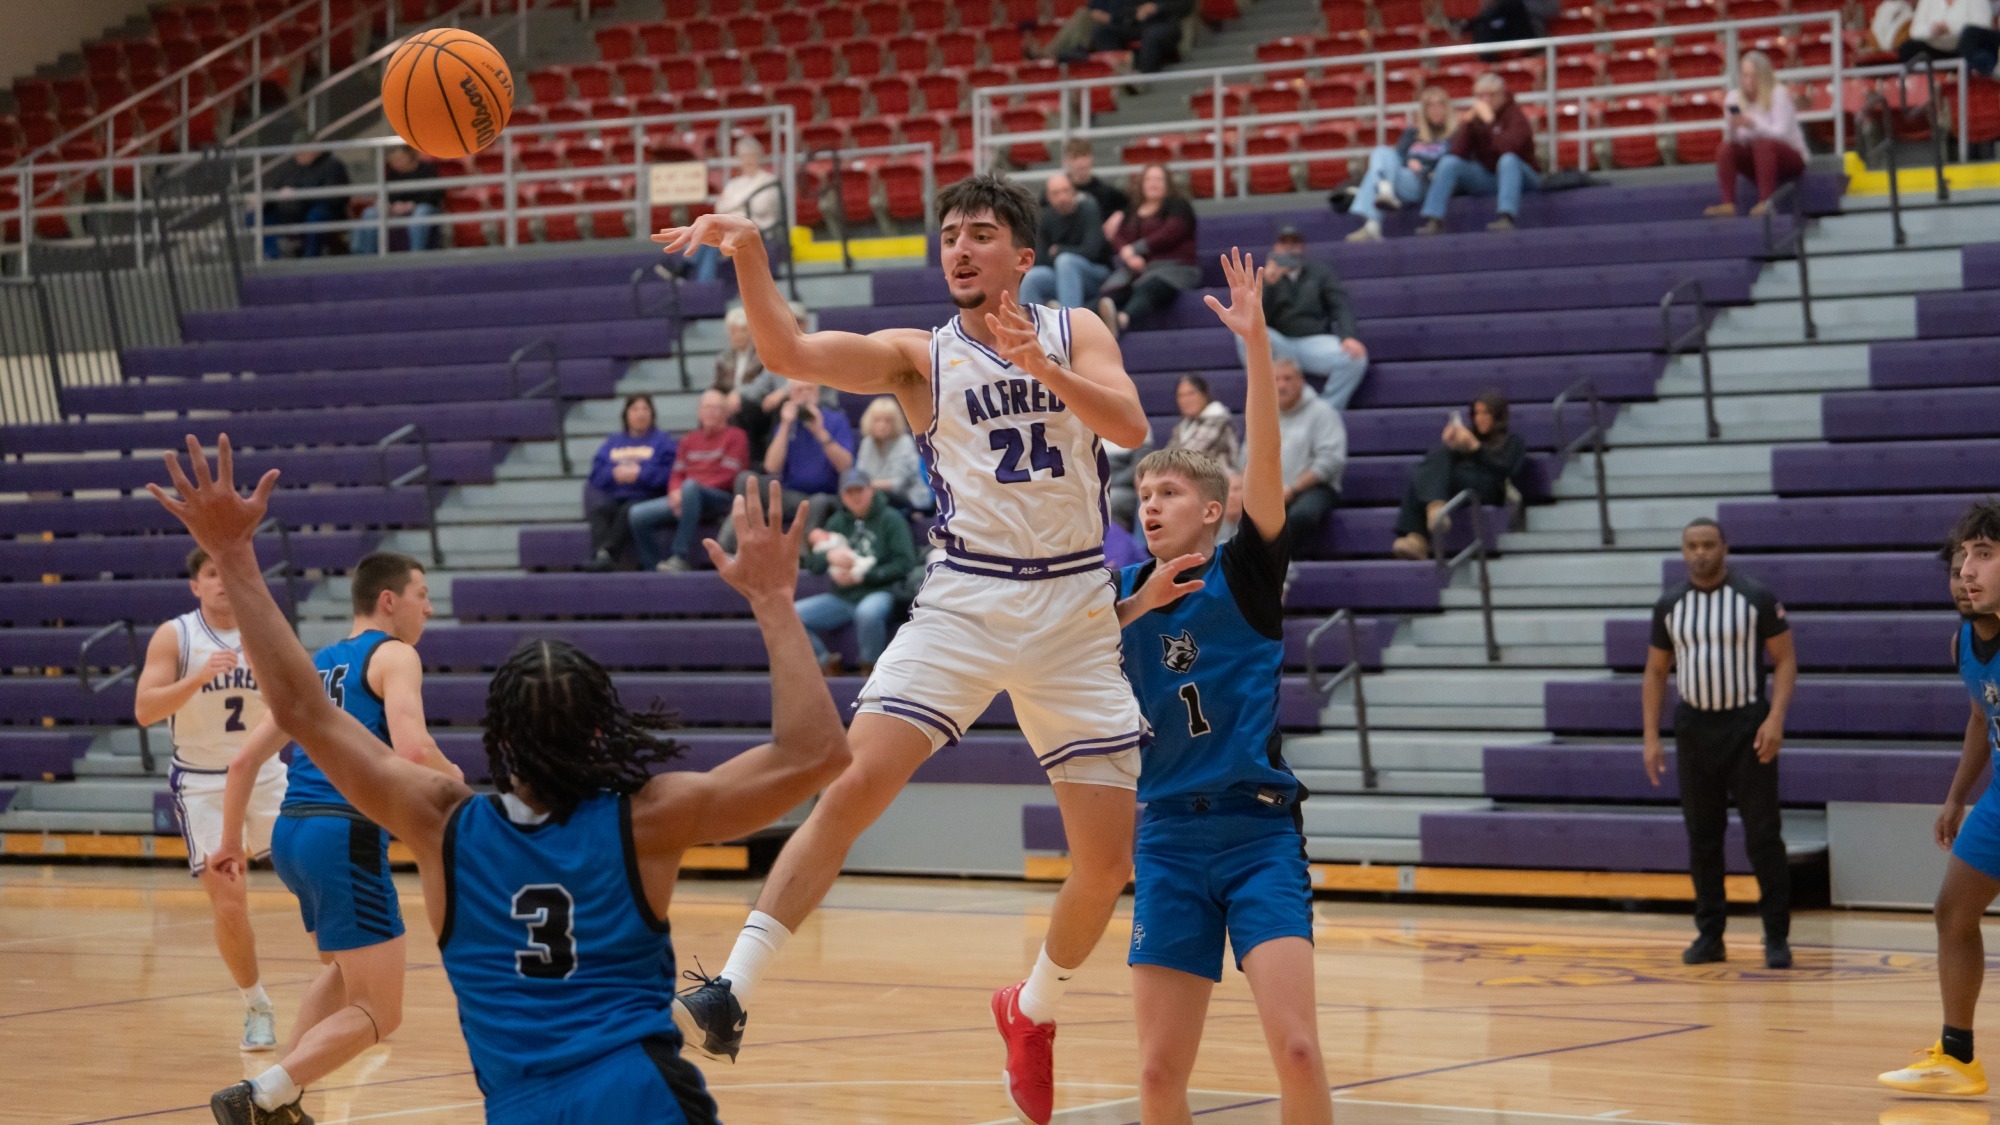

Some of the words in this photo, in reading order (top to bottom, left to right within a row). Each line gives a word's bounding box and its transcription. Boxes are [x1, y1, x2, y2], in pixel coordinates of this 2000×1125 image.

[460, 75, 495, 149] Wilson
[988, 422, 1065, 485] 24
[202, 667, 258, 693] ALFRE
[1178, 681, 1212, 738] 1
[224, 695, 247, 733] 2
[510, 882, 579, 981] 3
